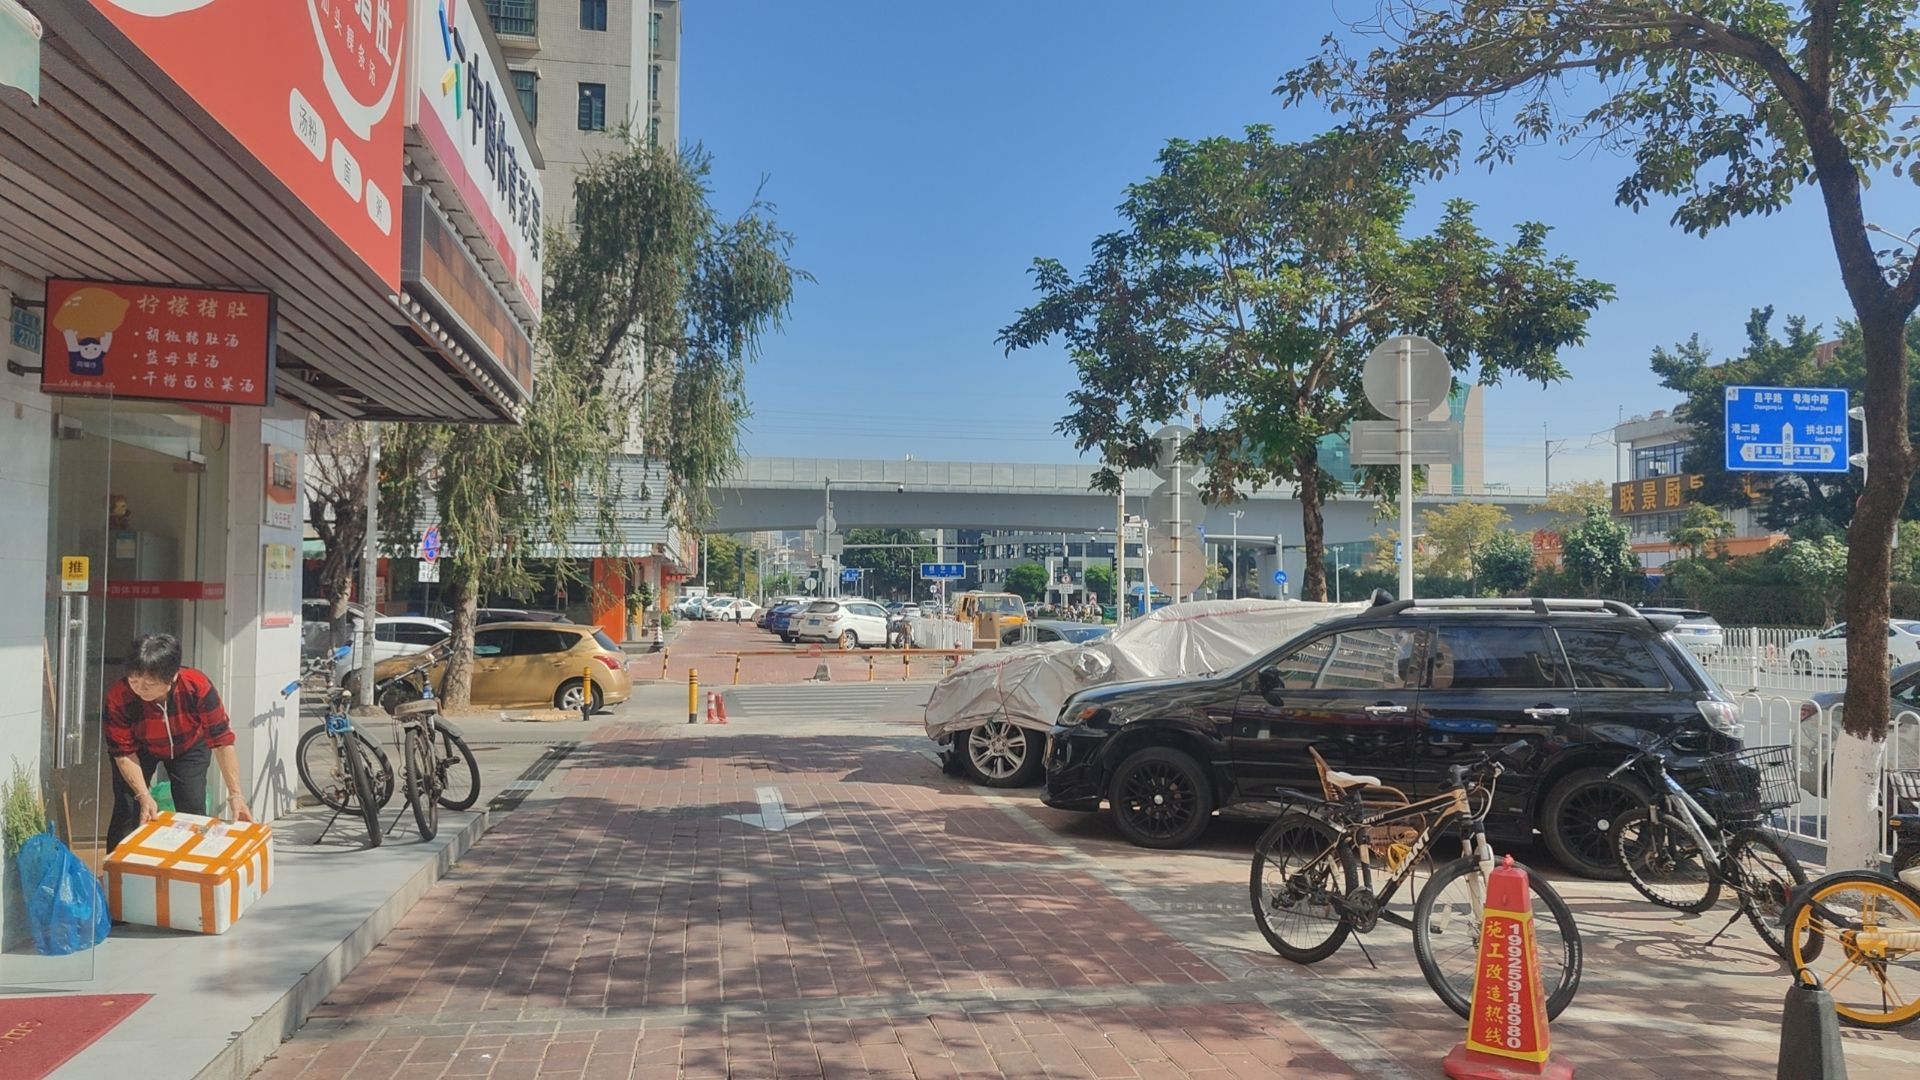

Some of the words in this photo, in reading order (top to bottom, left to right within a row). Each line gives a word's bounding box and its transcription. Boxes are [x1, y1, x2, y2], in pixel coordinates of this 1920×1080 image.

[299, 104, 318, 147] 汤粉
[467, 52, 540, 263] 中国体育彩票
[136, 294, 249, 320] 柠檬猪肚
[18, 329, 36, 348] 270
[145, 327, 240, 349] 胡椒猪肚汤
[145, 349, 220, 369] 益母草汤
[1754, 392, 1782, 404] 昌平路
[1731, 423, 1760, 434] 港二路
[1806, 425, 1843, 435] 拱北口岸
[69, 560, 83, 573] 推
[1484, 920, 1505, 1047] 施工改造热线
[1506, 923, 1523, 1049] 19925918980
